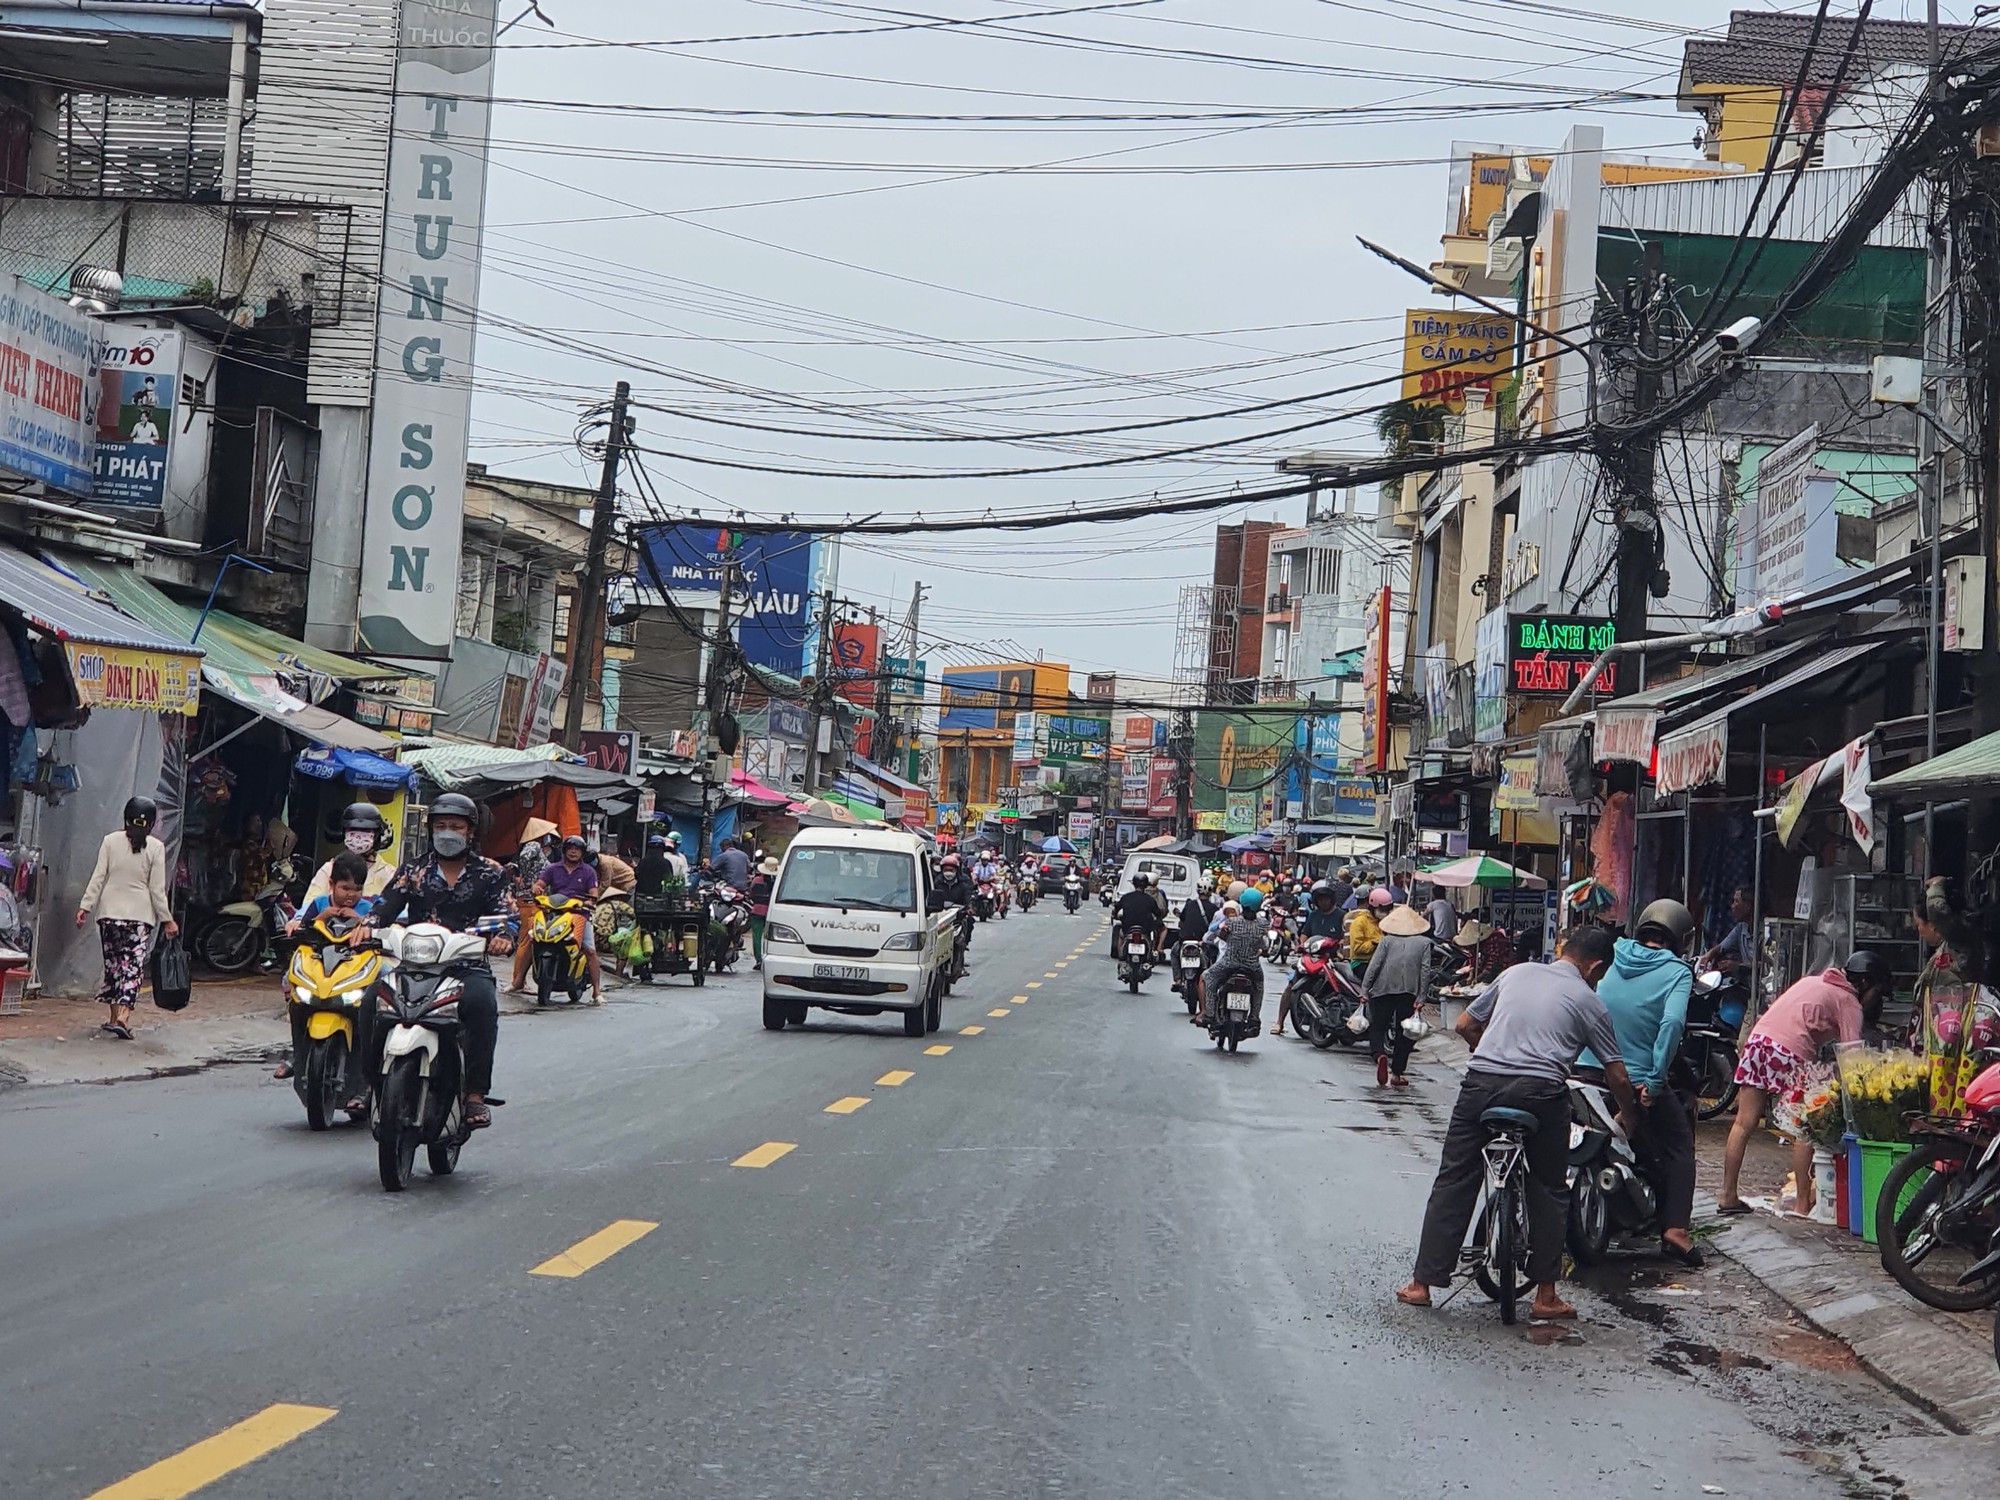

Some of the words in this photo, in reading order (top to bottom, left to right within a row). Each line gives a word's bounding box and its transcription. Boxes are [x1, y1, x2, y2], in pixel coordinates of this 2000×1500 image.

[407, 25, 488, 46] THUỐC
[402, 97, 458, 383] TRUNG
[1411, 316, 1450, 341] TIỆM
[128, 346, 155, 366] 10
[108, 455, 164, 480] PHÁT
[387, 422, 436, 593] SƠN
[672, 562, 703, 580] NHÀ
[1520, 618, 1585, 650] BÁNH
[1515, 649, 1571, 691] TẤN
